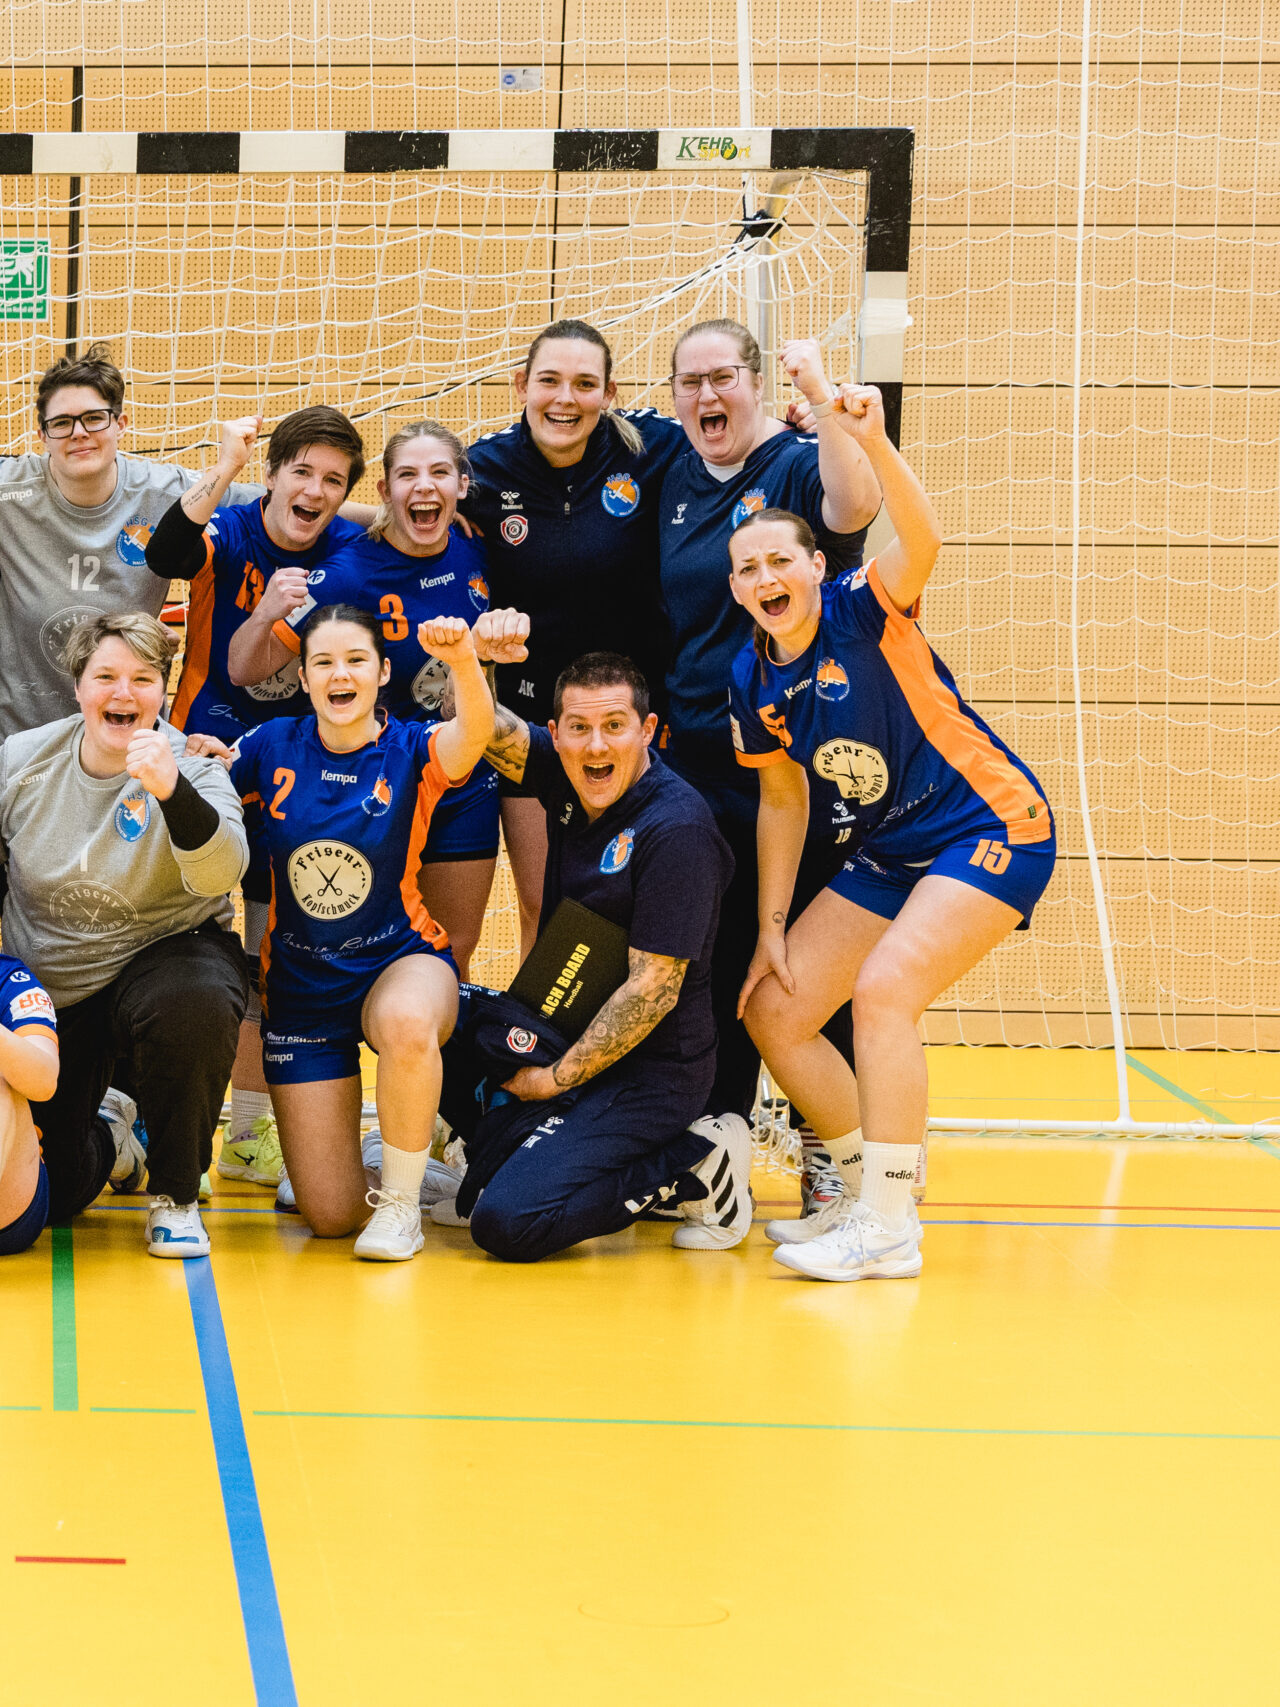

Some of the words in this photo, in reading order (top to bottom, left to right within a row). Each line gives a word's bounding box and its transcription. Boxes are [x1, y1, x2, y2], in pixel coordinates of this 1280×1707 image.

[126, 515, 148, 528] HSG
[67, 553, 101, 592] 12
[420, 572, 455, 590] Kempa
[379, 594, 410, 641] 3
[251, 682, 297, 699] opfschmuck
[518, 679, 535, 698] AK
[321, 769, 357, 786] Kempa
[269, 766, 297, 821] 2
[296, 845, 363, 870] Friseur
[969, 839, 1013, 875] 15
[301, 892, 361, 916] Kopfschmuck
[555, 943, 591, 989] BOARD
[563, 980, 584, 1009] Handball
